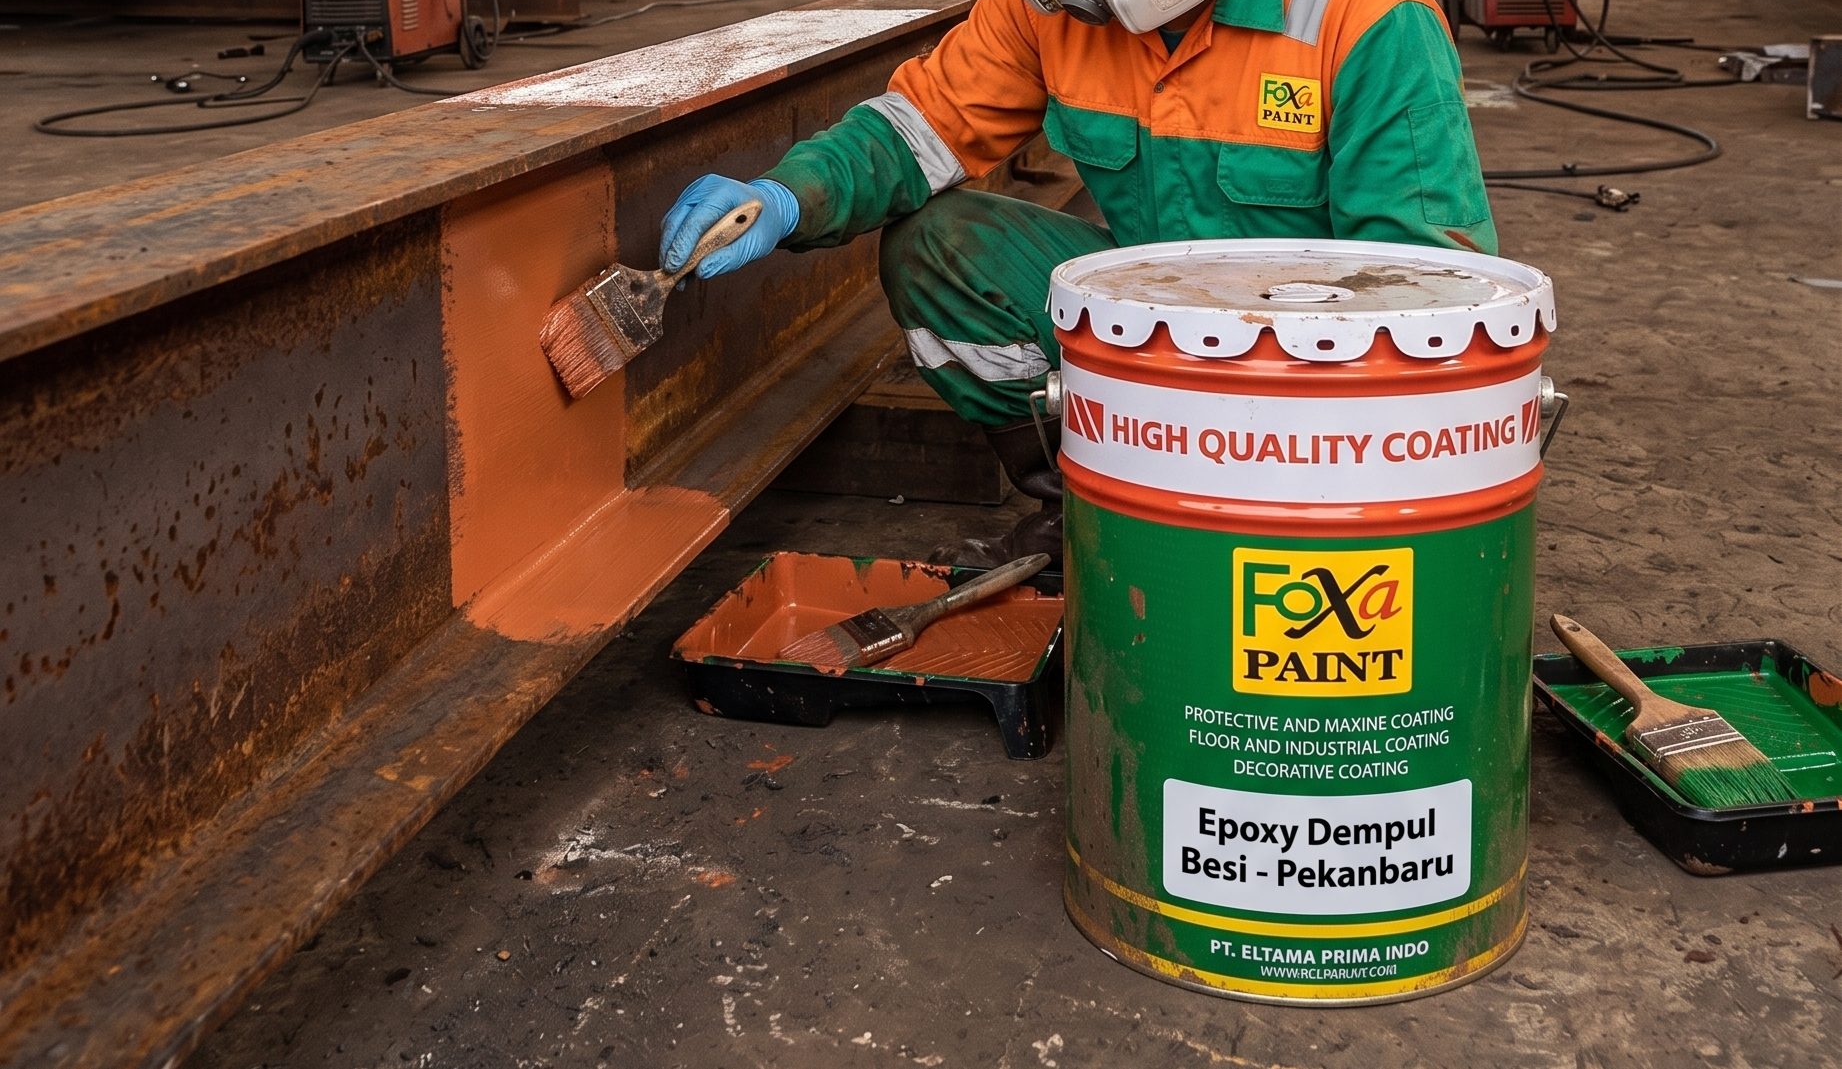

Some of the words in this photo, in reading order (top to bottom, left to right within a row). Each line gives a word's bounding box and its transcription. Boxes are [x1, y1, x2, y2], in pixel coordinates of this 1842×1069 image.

[1262, 109, 1315, 125] PAINT
[1112, 414, 1188, 455] HIGH
[1198, 429, 1373, 464] QUALITY
[1382, 414, 1516, 462] COATING
[1243, 648, 1403, 683] PAINT
[1184, 705, 1279, 732] PROTECTIVE
[1283, 716, 1320, 733] AND
[1325, 715, 1386, 733] MAXINE
[1391, 705, 1454, 730] COATING
[1189, 729, 1240, 751] FLOOR
[1244, 737, 1280, 754] AND
[1285, 739, 1381, 756] INDUSTRIAL
[1385, 729, 1450, 753] COATING
[1233, 760, 1334, 779] DECORATIVE
[1338, 760, 1409, 779] COATING
[1199, 807, 1299, 853] Epoxy
[1308, 808, 1436, 849] Dempul
[1181, 846, 1246, 882] Besi
[1277, 854, 1454, 888] Pekanbaru
[1210, 939, 1236, 958] PT.
[1241, 945, 1316, 964] ELTAMA
[1321, 944, 1380, 964] PRIMA
[1386, 940, 1430, 959] INDO
